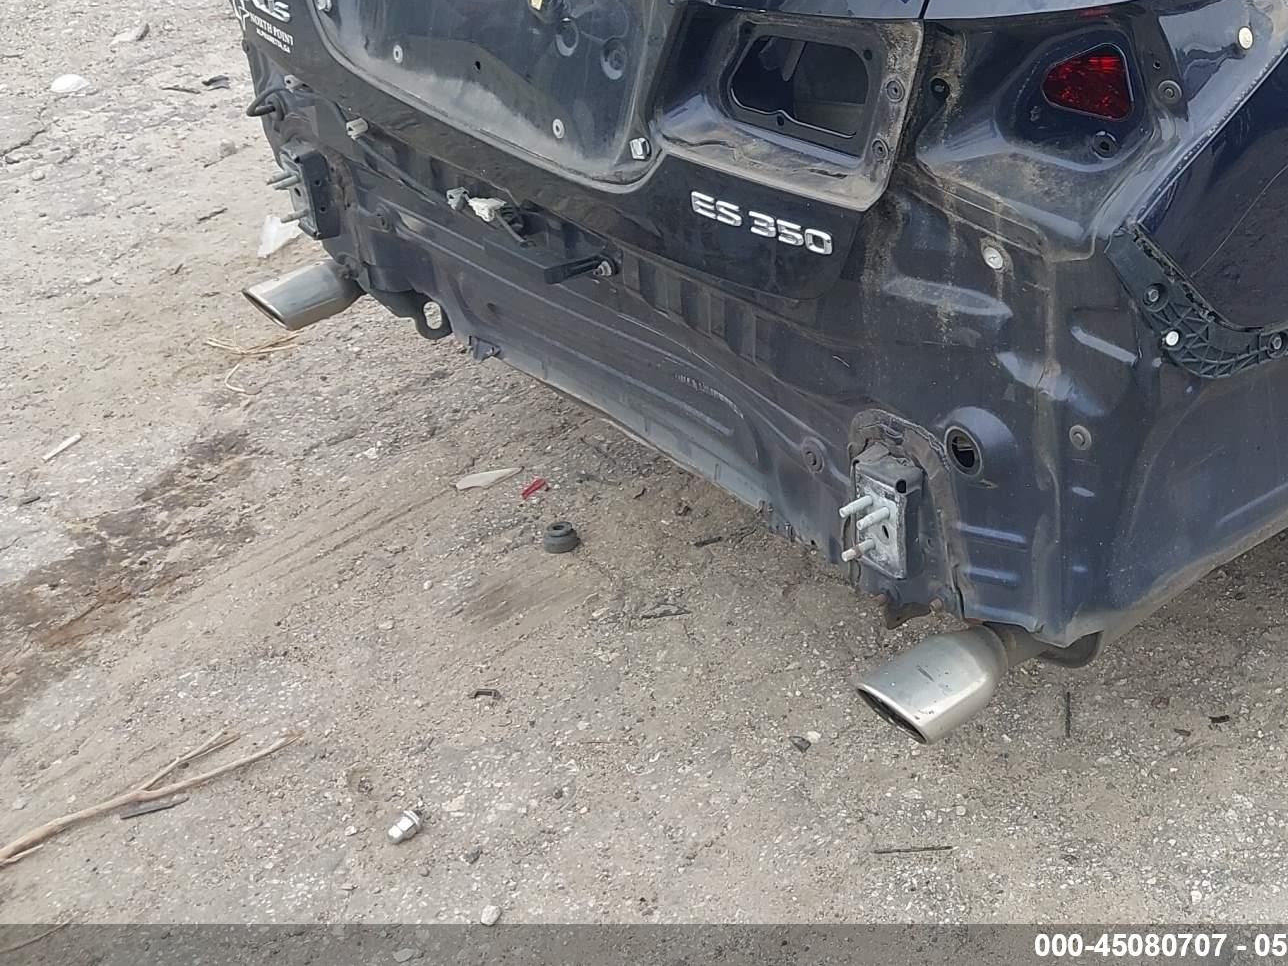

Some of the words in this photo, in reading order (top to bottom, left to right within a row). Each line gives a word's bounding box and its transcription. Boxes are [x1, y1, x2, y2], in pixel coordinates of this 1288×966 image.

[250, 13, 273, 34] NORTH
[272, 26, 294, 46] POINT
[691, 191, 743, 227] ES
[748, 211, 833, 255] 350
